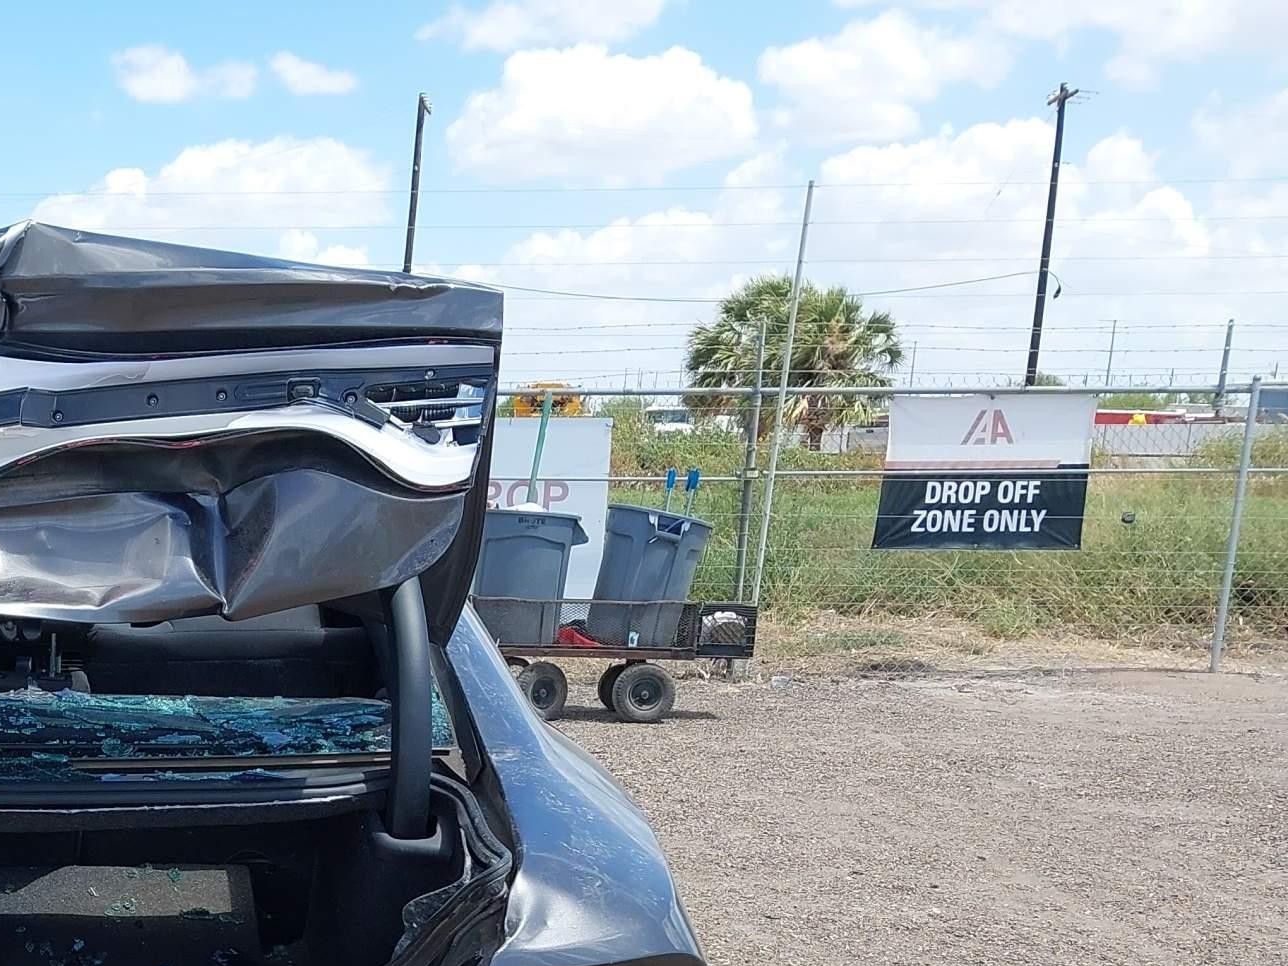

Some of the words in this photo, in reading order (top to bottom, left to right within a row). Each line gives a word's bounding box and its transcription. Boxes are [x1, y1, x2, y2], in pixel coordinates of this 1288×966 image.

[924, 481, 991, 504] DROP
[997, 481, 1041, 504] OFF
[911, 510, 976, 532] ZONE
[983, 510, 1047, 532] ONLY
